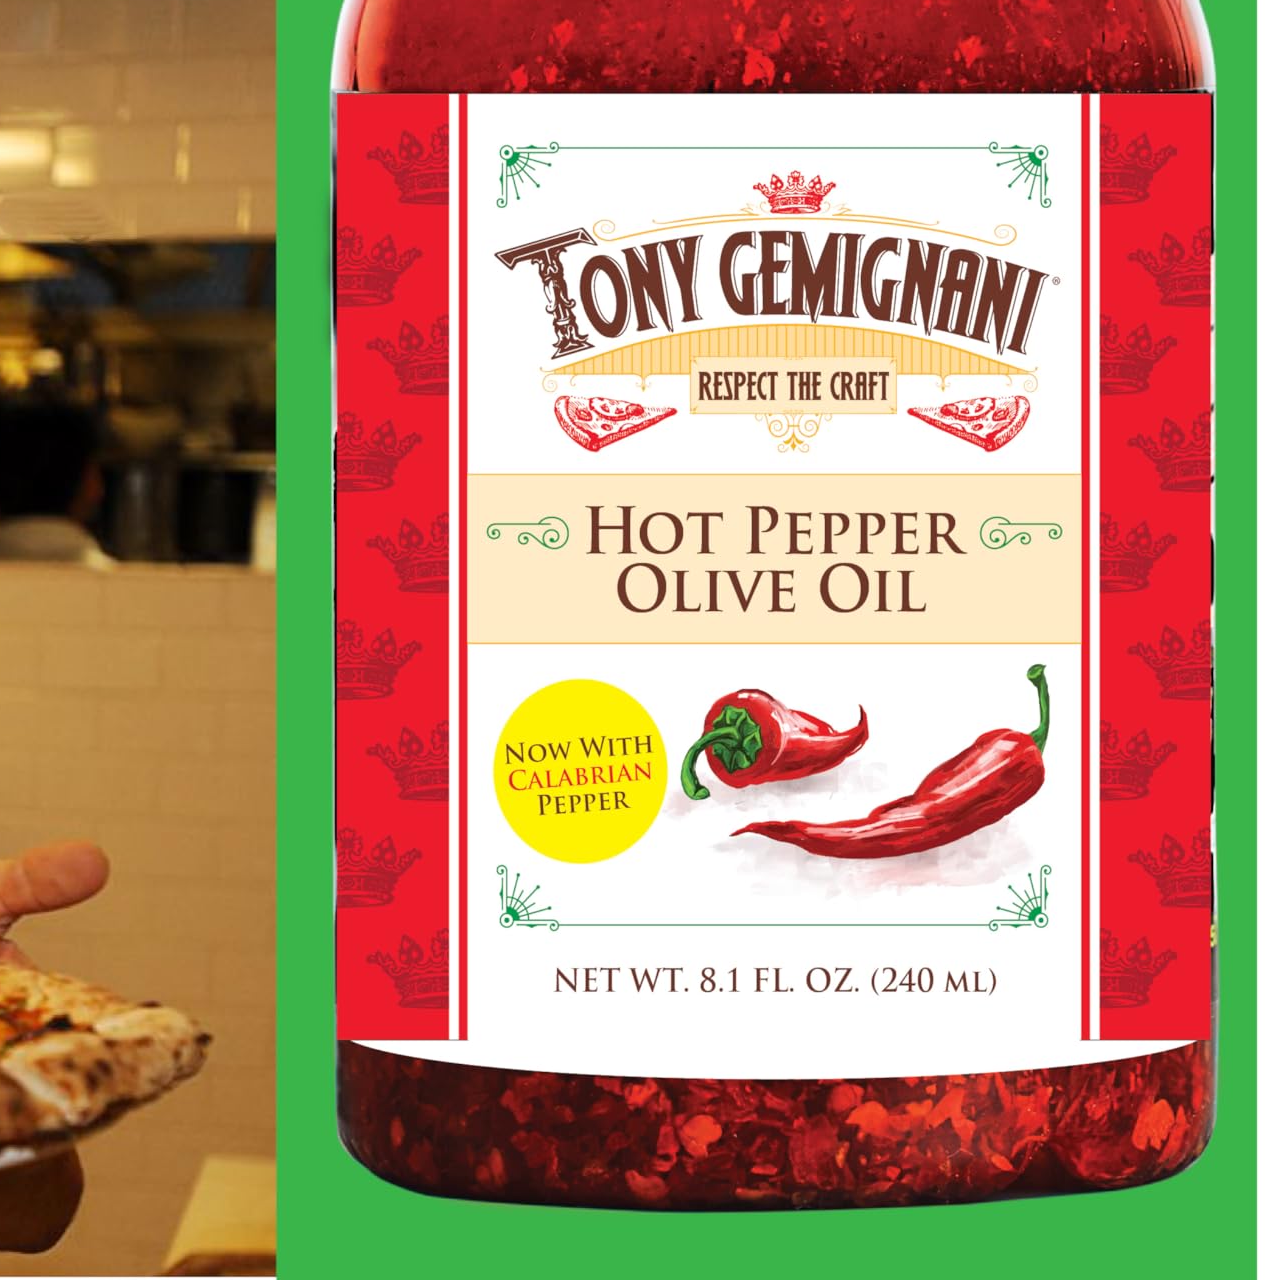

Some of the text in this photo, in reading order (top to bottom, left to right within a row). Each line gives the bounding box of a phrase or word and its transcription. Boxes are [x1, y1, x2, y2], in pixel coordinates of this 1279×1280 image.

[494, 226, 1051, 360] TONY GEMIGNANI
[698, 371, 890, 401] RESPECT THE CRAFT
[585, 504, 967, 556] HOT PEPPER
[616, 562, 928, 614] OLIVE OIL
[505, 735, 653, 765] NOW WITH
[508, 762, 652, 791] CALABRIAN
[538, 792, 631, 816] PEPPER
[555, 966, 622, 994] NET
[629, 966, 691, 994] WT.
[699, 966, 740, 994] 8.1
[753, 966, 795, 994] FL.
[805, 966, 860, 994] OZ.
[870, 966, 935, 996] (240
